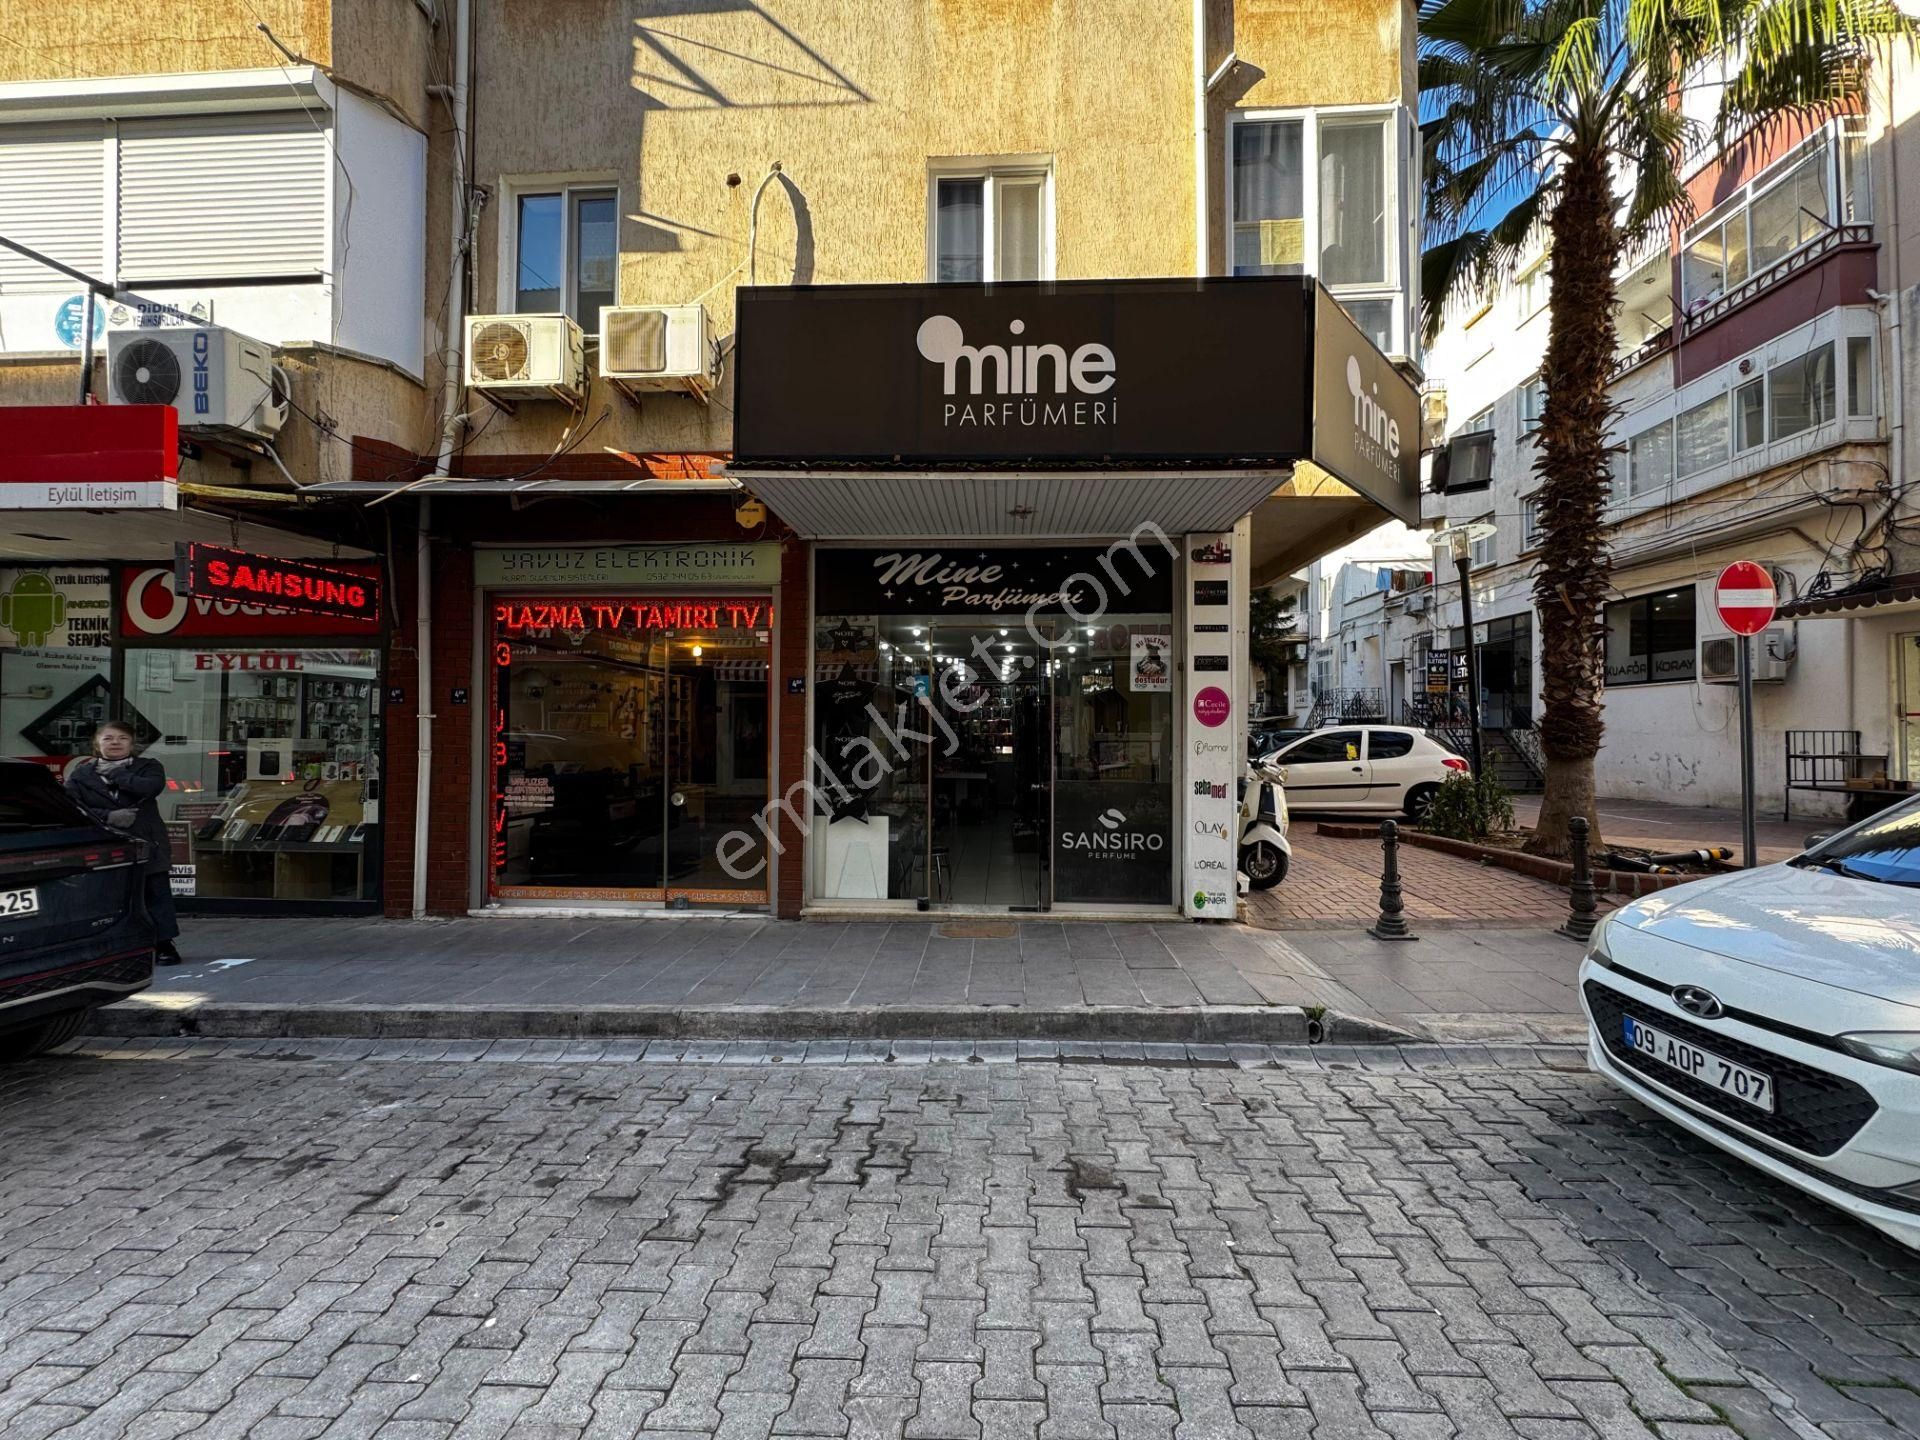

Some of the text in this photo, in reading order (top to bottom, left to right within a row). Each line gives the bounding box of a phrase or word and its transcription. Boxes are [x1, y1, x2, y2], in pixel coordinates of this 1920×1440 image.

[917, 315, 1117, 396] mine
[194, 333, 209, 414] BEKO
[944, 397, 1117, 427] PARFÜMERİ
[1347, 355, 1400, 458] mine
[48, 484, 137, 505] Eylül İletişim
[502, 547, 756, 570] YAVUZ ELEKTRONİK
[873, 552, 1004, 586] Mine
[207, 559, 366, 608] SAMSUNG
[941, 586, 1086, 612] Parfümeri
[68, 615, 109, 631] TEKNİK
[592, 605, 625, 629] TV
[631, 605, 718, 629] TAMIRI
[728, 605, 761, 629] TV
[194, 650, 304, 671] EYLÜL
[1452, 653, 1468, 667] İLK
[1656, 658, 1695, 673] KORAY
[1135, 676, 1168, 684] dostudur
[1194, 779, 1227, 799] sebamed
[1194, 820, 1225, 834] OLAY
[1088, 852, 1137, 860] PERFUME
[1634, 1025, 1765, 1103] 09 AOP 707
